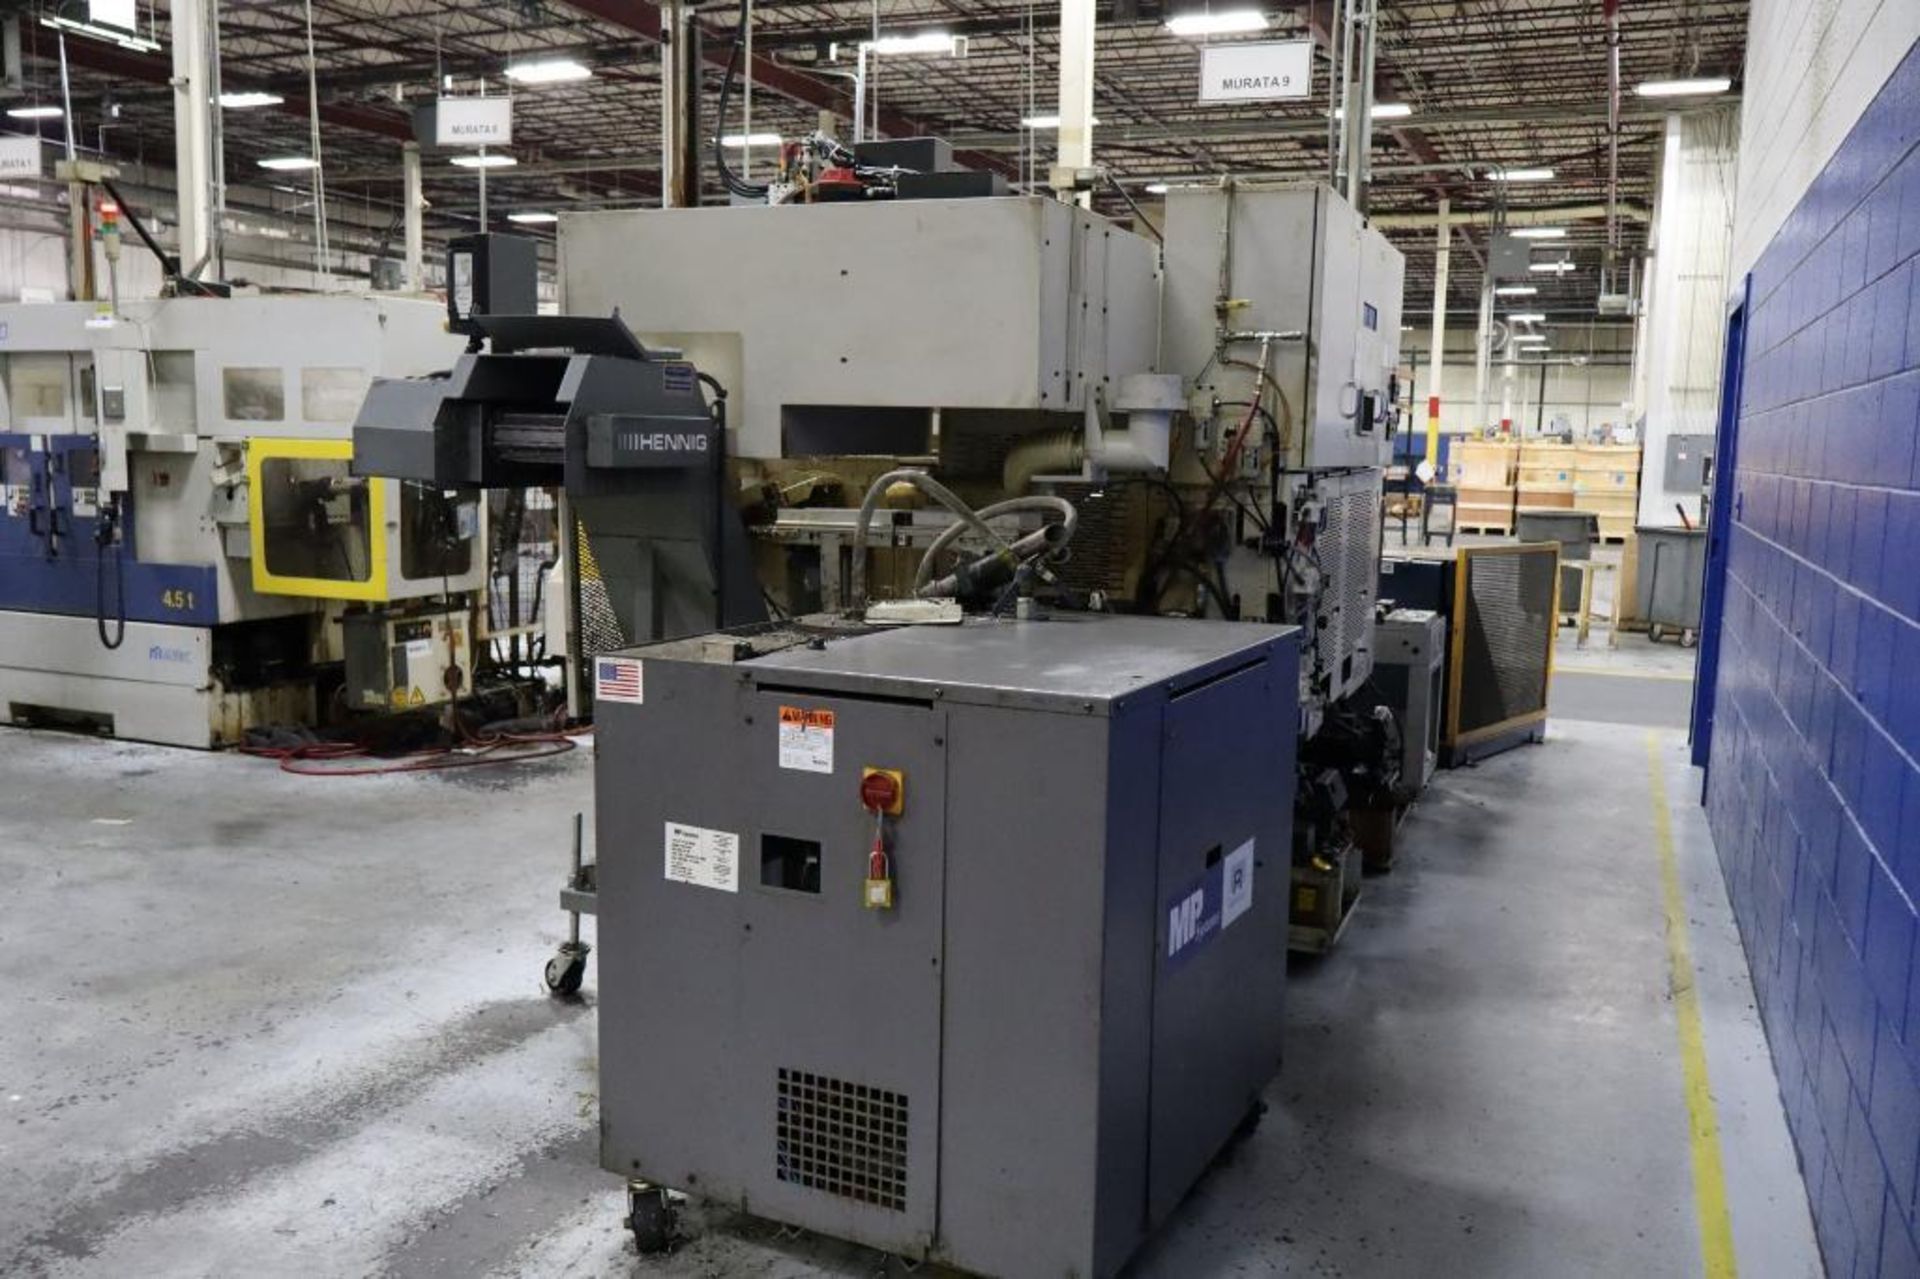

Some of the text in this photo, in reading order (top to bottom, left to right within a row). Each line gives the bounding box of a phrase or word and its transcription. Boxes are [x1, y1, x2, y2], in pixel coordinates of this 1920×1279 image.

[1222, 75, 1291, 91] MURATA 9
[451, 124, 491, 135] MURATA
[640, 433, 707, 451] HENNIG
[1167, 888, 1204, 958] MP
